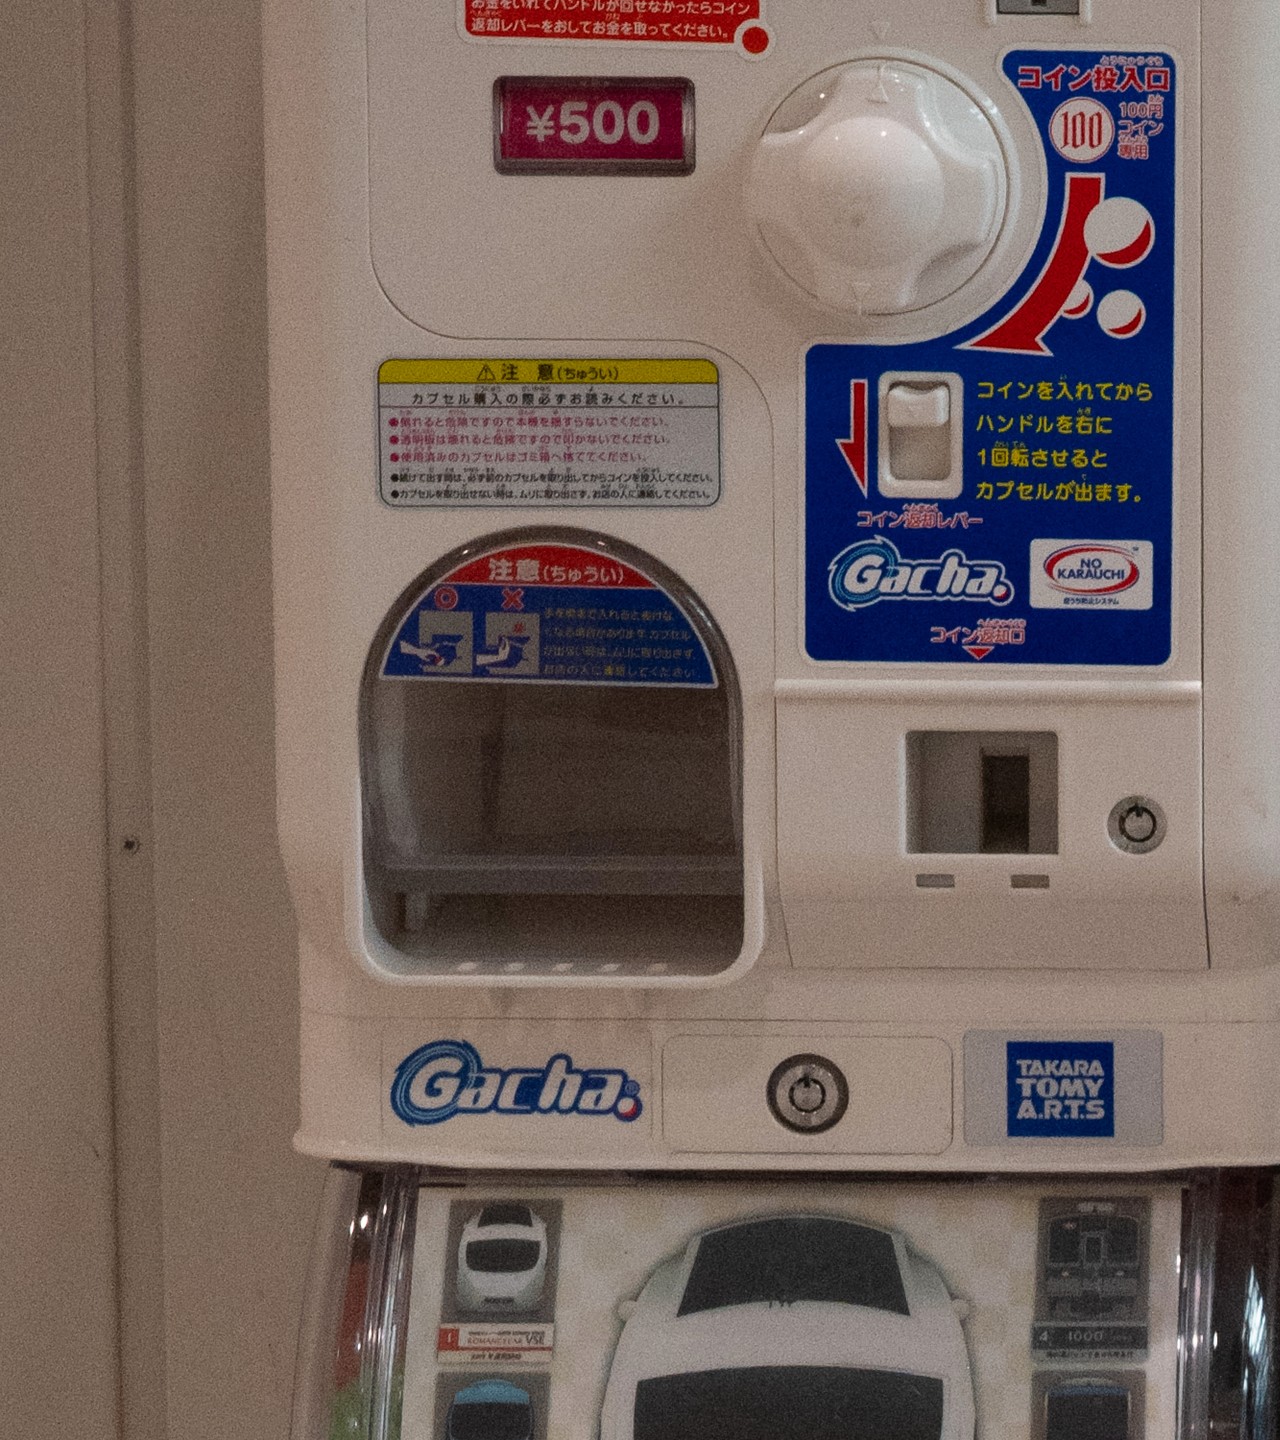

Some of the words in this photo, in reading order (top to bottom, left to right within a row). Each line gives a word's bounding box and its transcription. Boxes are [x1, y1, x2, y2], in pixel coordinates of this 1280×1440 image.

[1018, 66, 1170, 92] コイン投入口
[1119, 102, 1164, 118] 100円
[526, 100, 660, 145] ¥500
[1061, 110, 1103, 149] 100
[1118, 121, 1163, 136] コイン
[977, 382, 1153, 401] コインを入れてから
[977, 415, 1113, 435] ハンドルを右に
[977, 449, 1108, 468] 1回転させると
[976, 482, 1142, 503] カプセルが出ます。
[857, 510, 984, 530] コイン返却レバー
[488, 558, 625, 583] 注意(ちゅうい)
[1080, 558, 1103, 569] NO
[1057, 569, 1125, 581] KARAUCHI
[930, 627, 1026, 644] コイン返却口
[1016, 1058, 1105, 1077] TAKARA
[1016, 1079, 1105, 1098] TOMY
[1068, 1330, 1103, 1342] 1000
